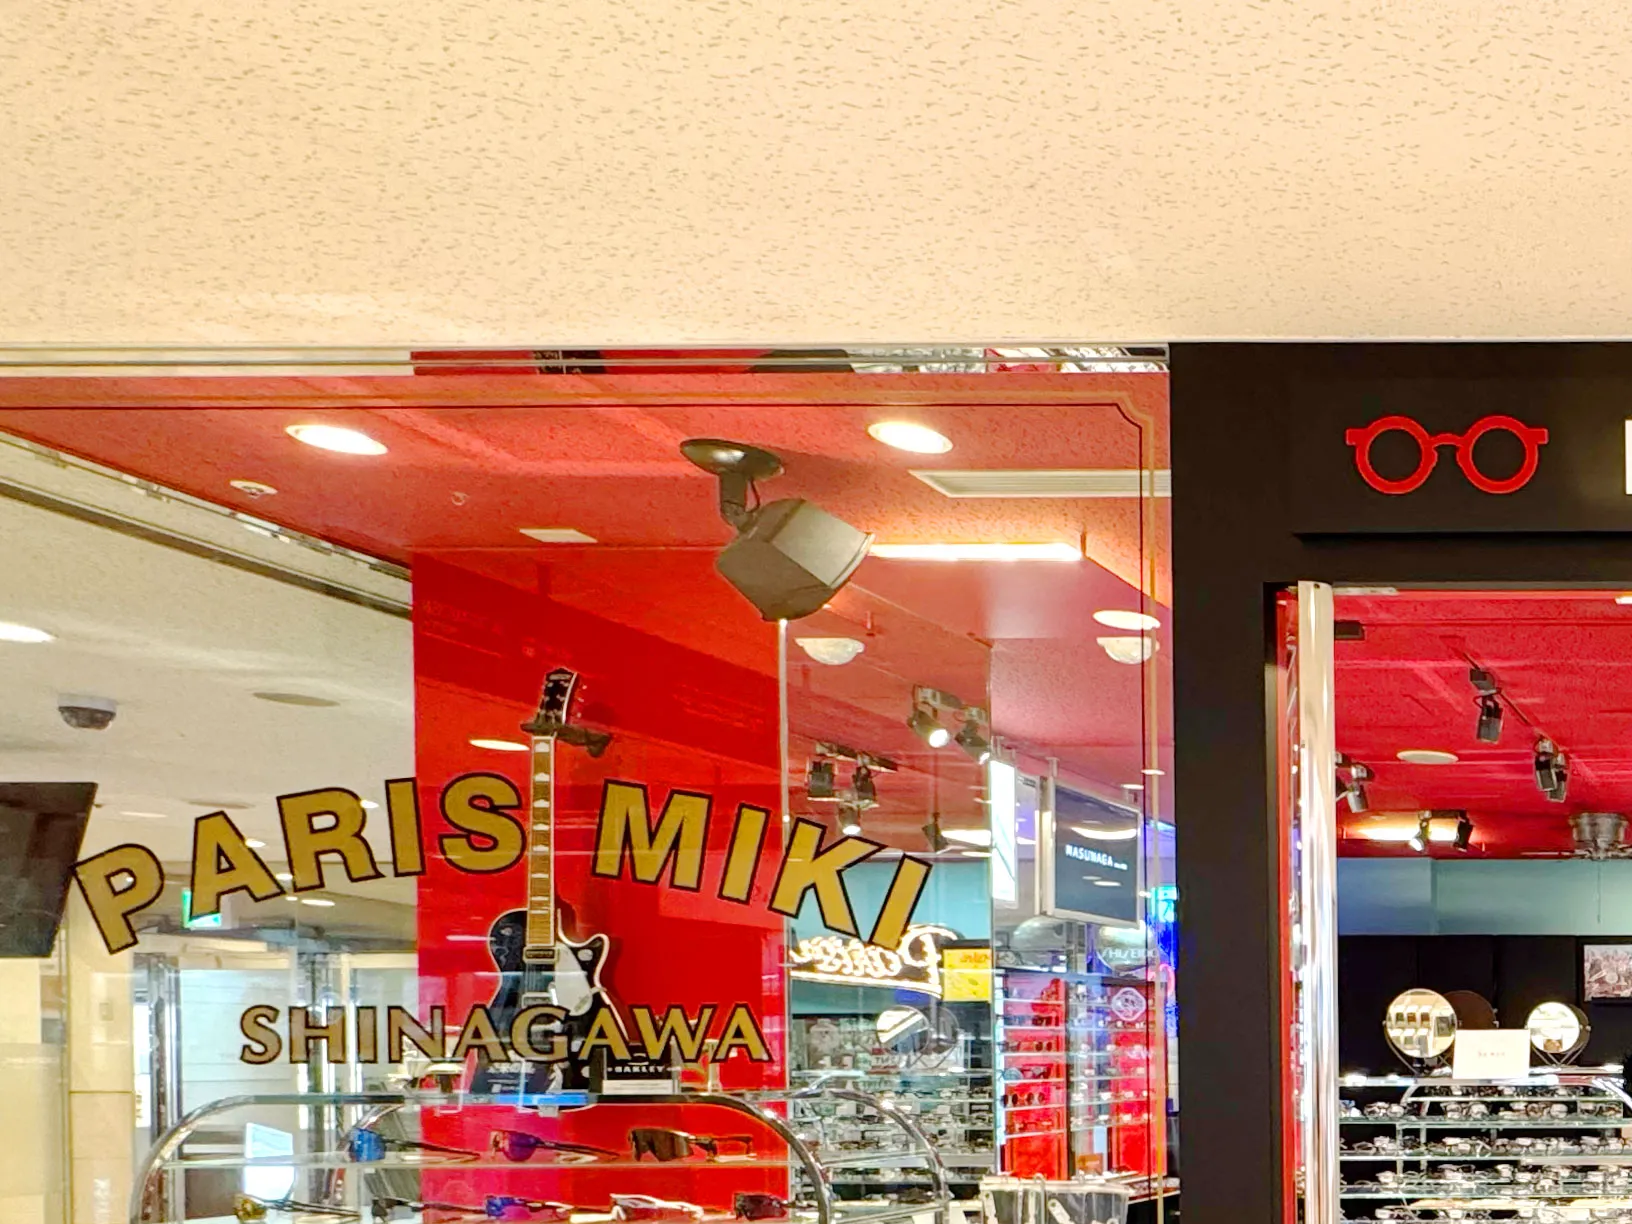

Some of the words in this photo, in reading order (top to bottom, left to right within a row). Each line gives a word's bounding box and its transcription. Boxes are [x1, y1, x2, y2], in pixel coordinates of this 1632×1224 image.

[71, 772, 524, 954] PARIS
[594, 779, 932, 950] MIKI
[239, 1002, 773, 1067] SHINAGAWA
